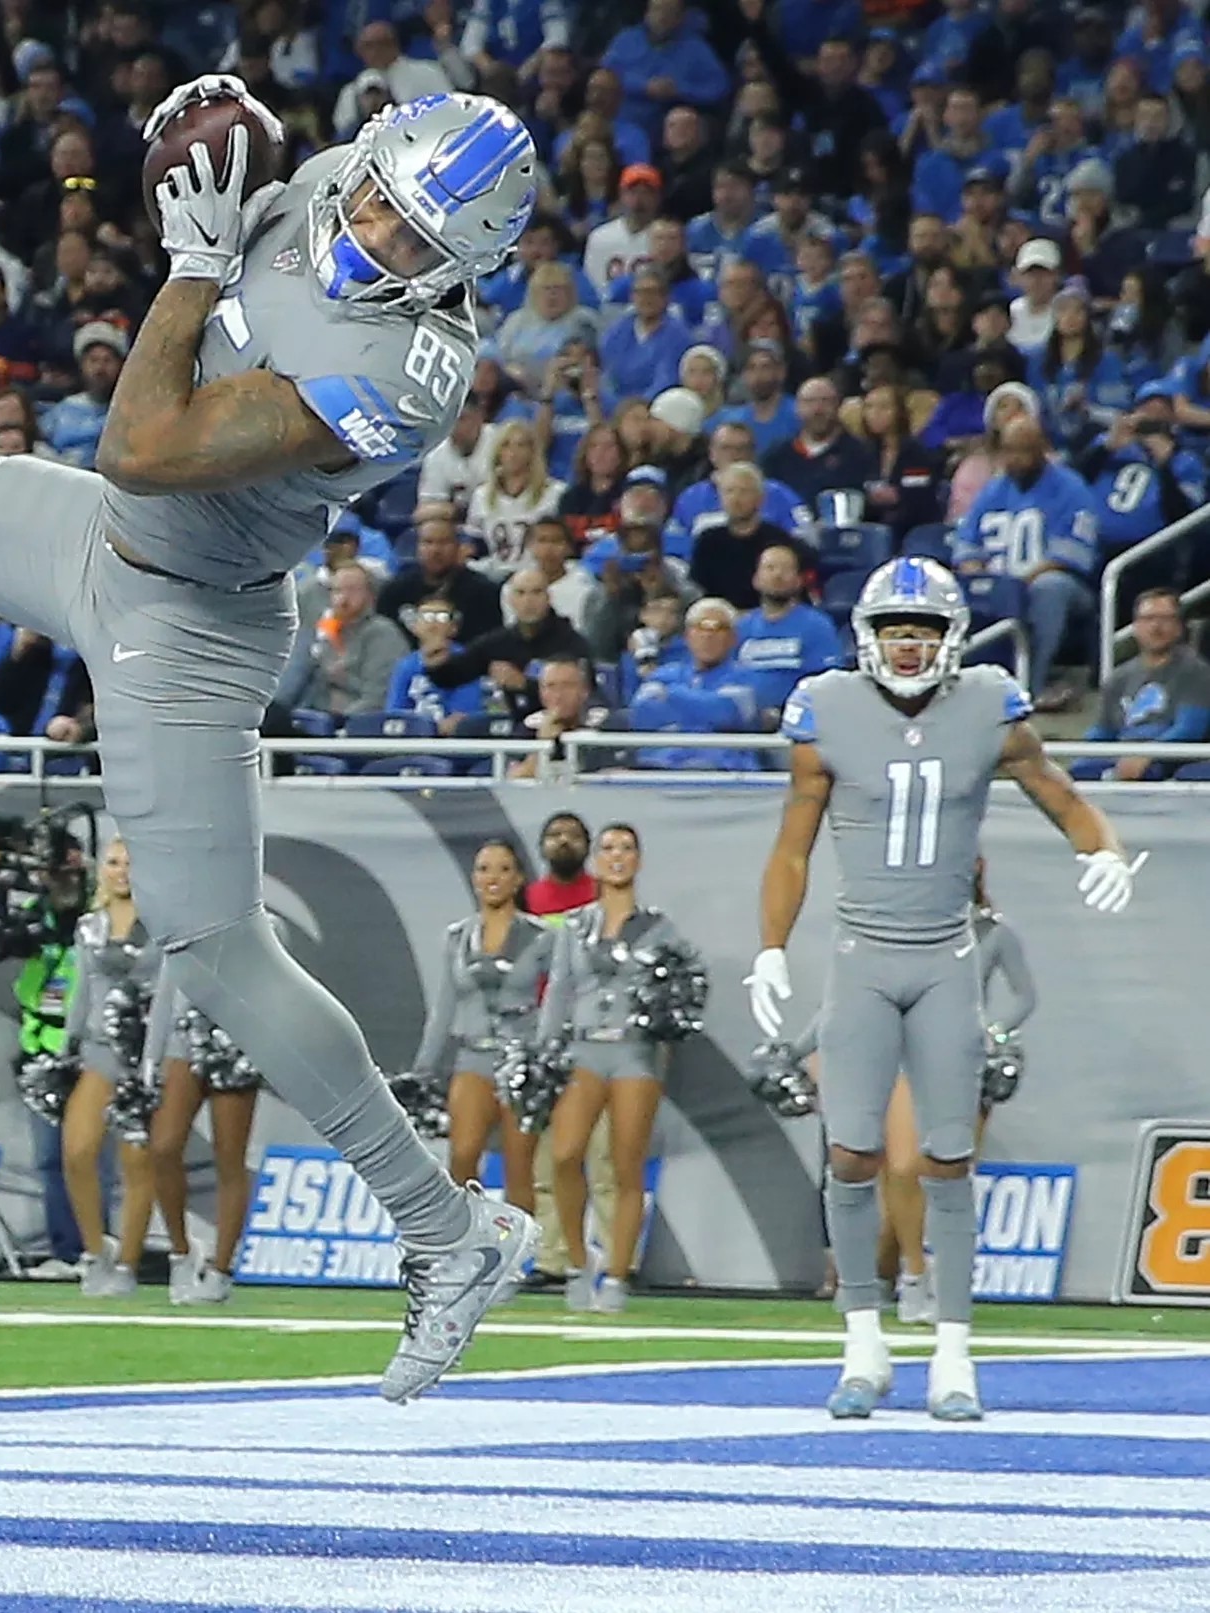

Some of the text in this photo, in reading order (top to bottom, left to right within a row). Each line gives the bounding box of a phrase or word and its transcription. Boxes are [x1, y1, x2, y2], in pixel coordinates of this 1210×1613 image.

[405, 325, 461, 407] 85
[1108, 462, 1152, 513] 9
[885, 758, 944, 867] 11
[239, 1236, 327, 1277] SOME
